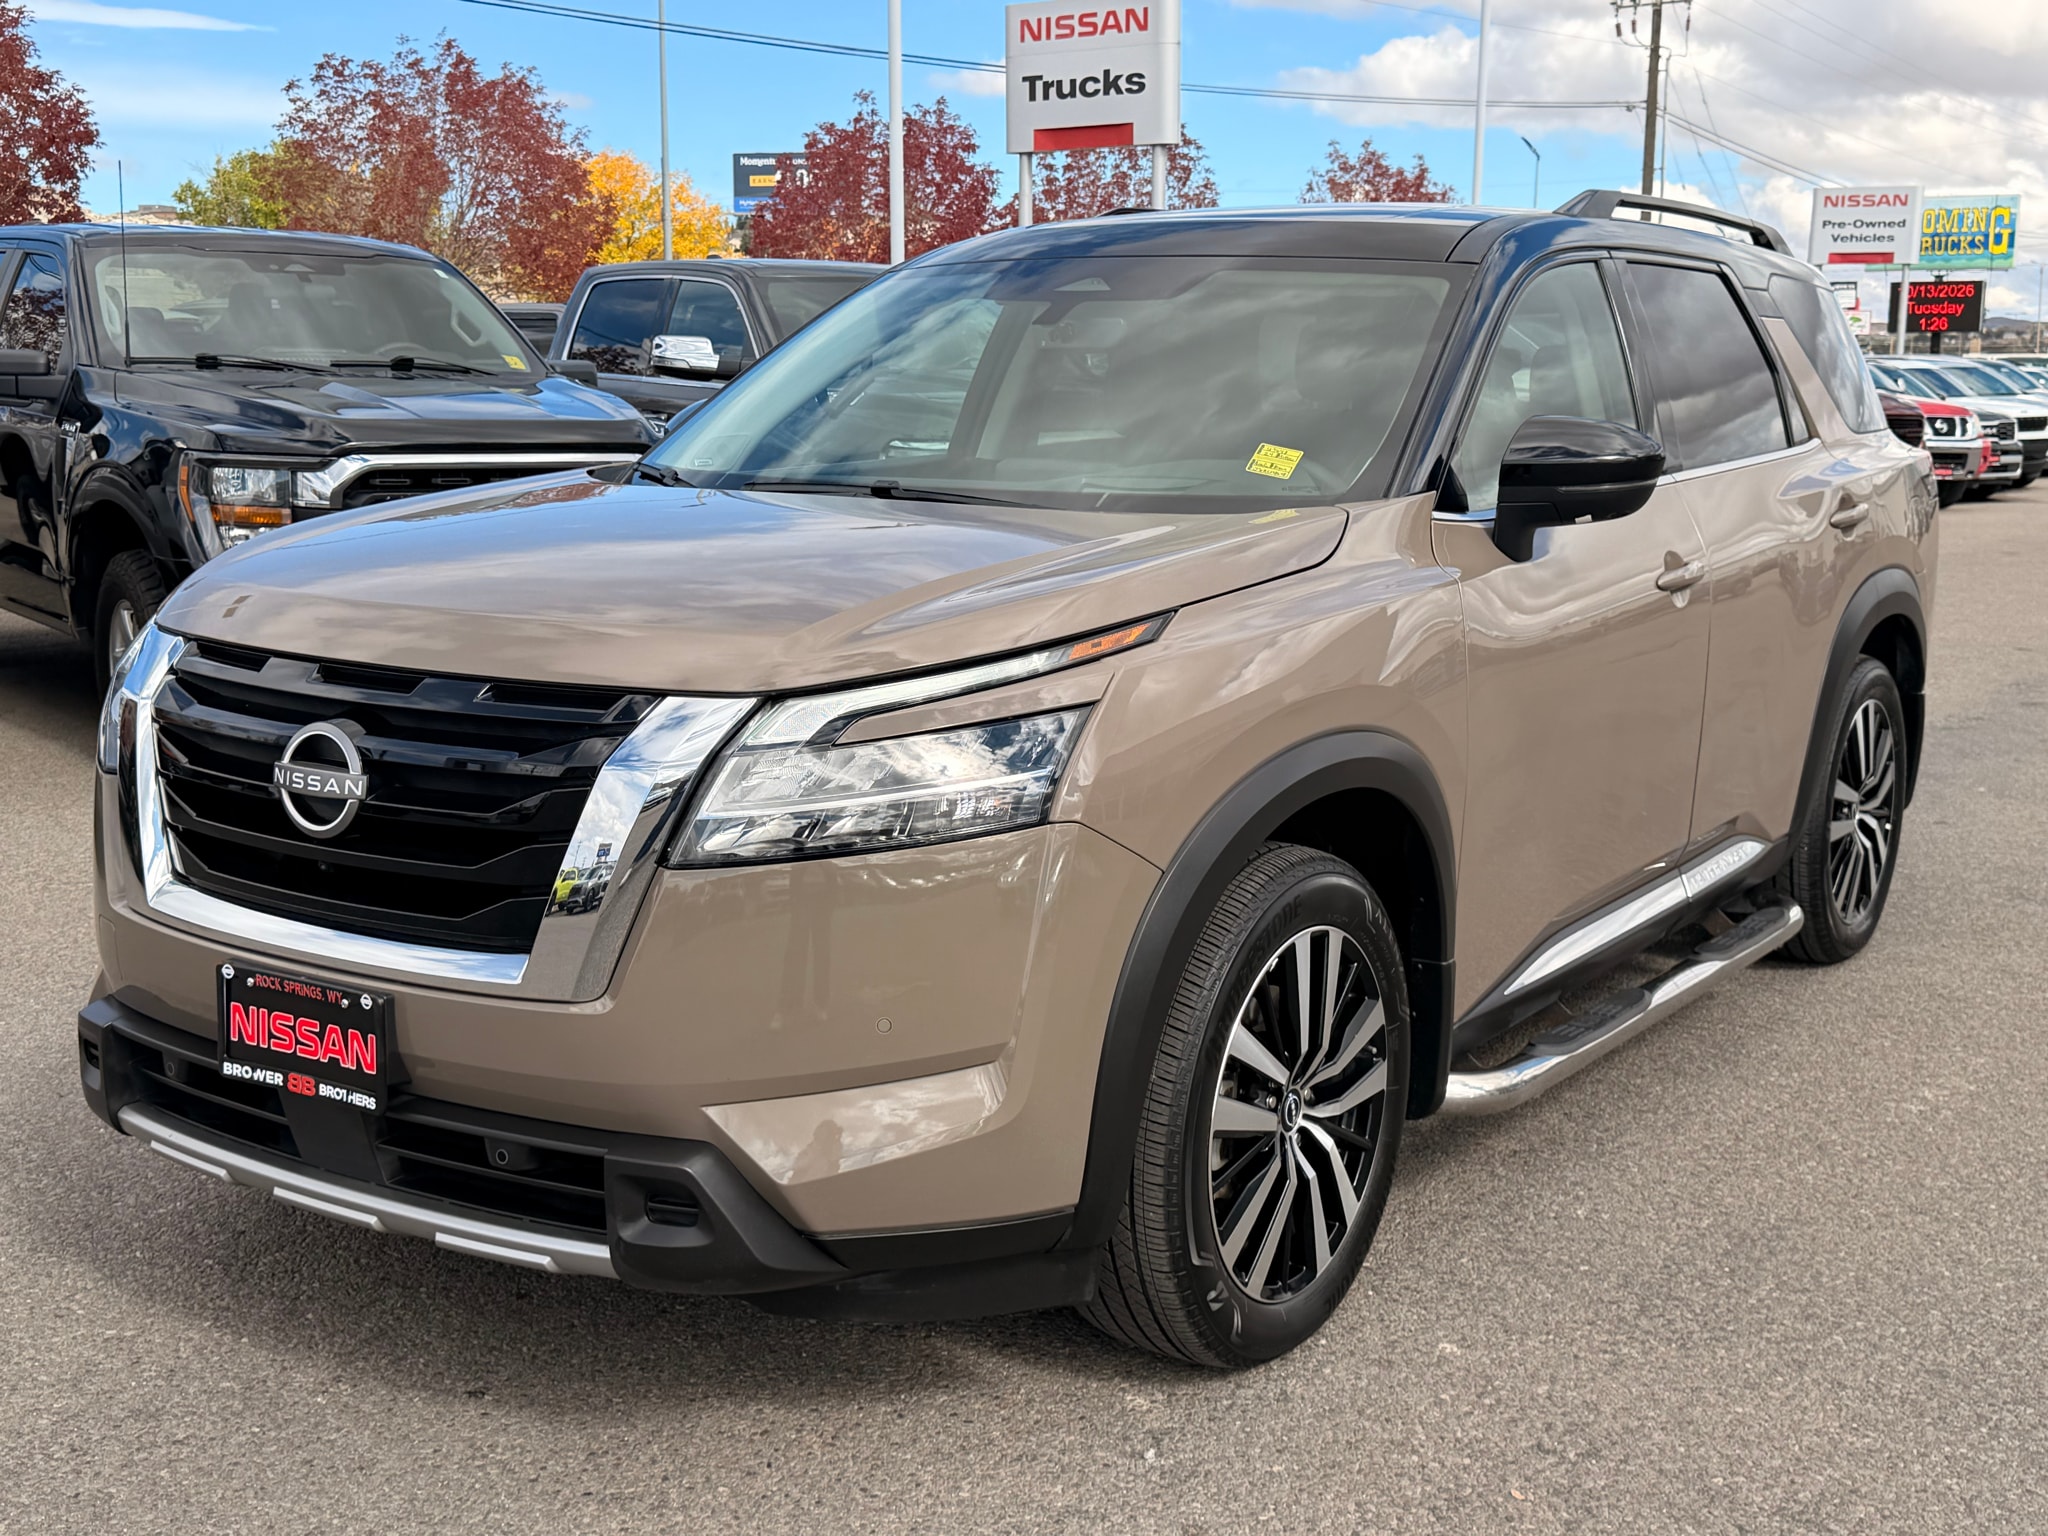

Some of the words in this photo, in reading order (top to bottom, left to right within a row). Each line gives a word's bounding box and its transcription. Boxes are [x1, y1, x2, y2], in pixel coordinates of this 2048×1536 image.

[1020, 7, 1149, 43] NISSAN
[1022, 69, 1146, 102] Trucks
[1823, 194, 1909, 208] NISSAN
[1822, 219, 1906, 229] Pre-Owned
[1831, 233, 1895, 243] Vehicles
[1898, 284, 1975, 298] 0/13/2026
[1919, 317, 1949, 331] 1:26
[274, 767, 363, 796] NISSAN
[255, 973, 282, 991] ROCK
[326, 989, 343, 1005] WY
[230, 1001, 377, 1075] NISSAN
[223, 1061, 284, 1086] BROWER
[319, 1083, 377, 1110] BROTHERS
